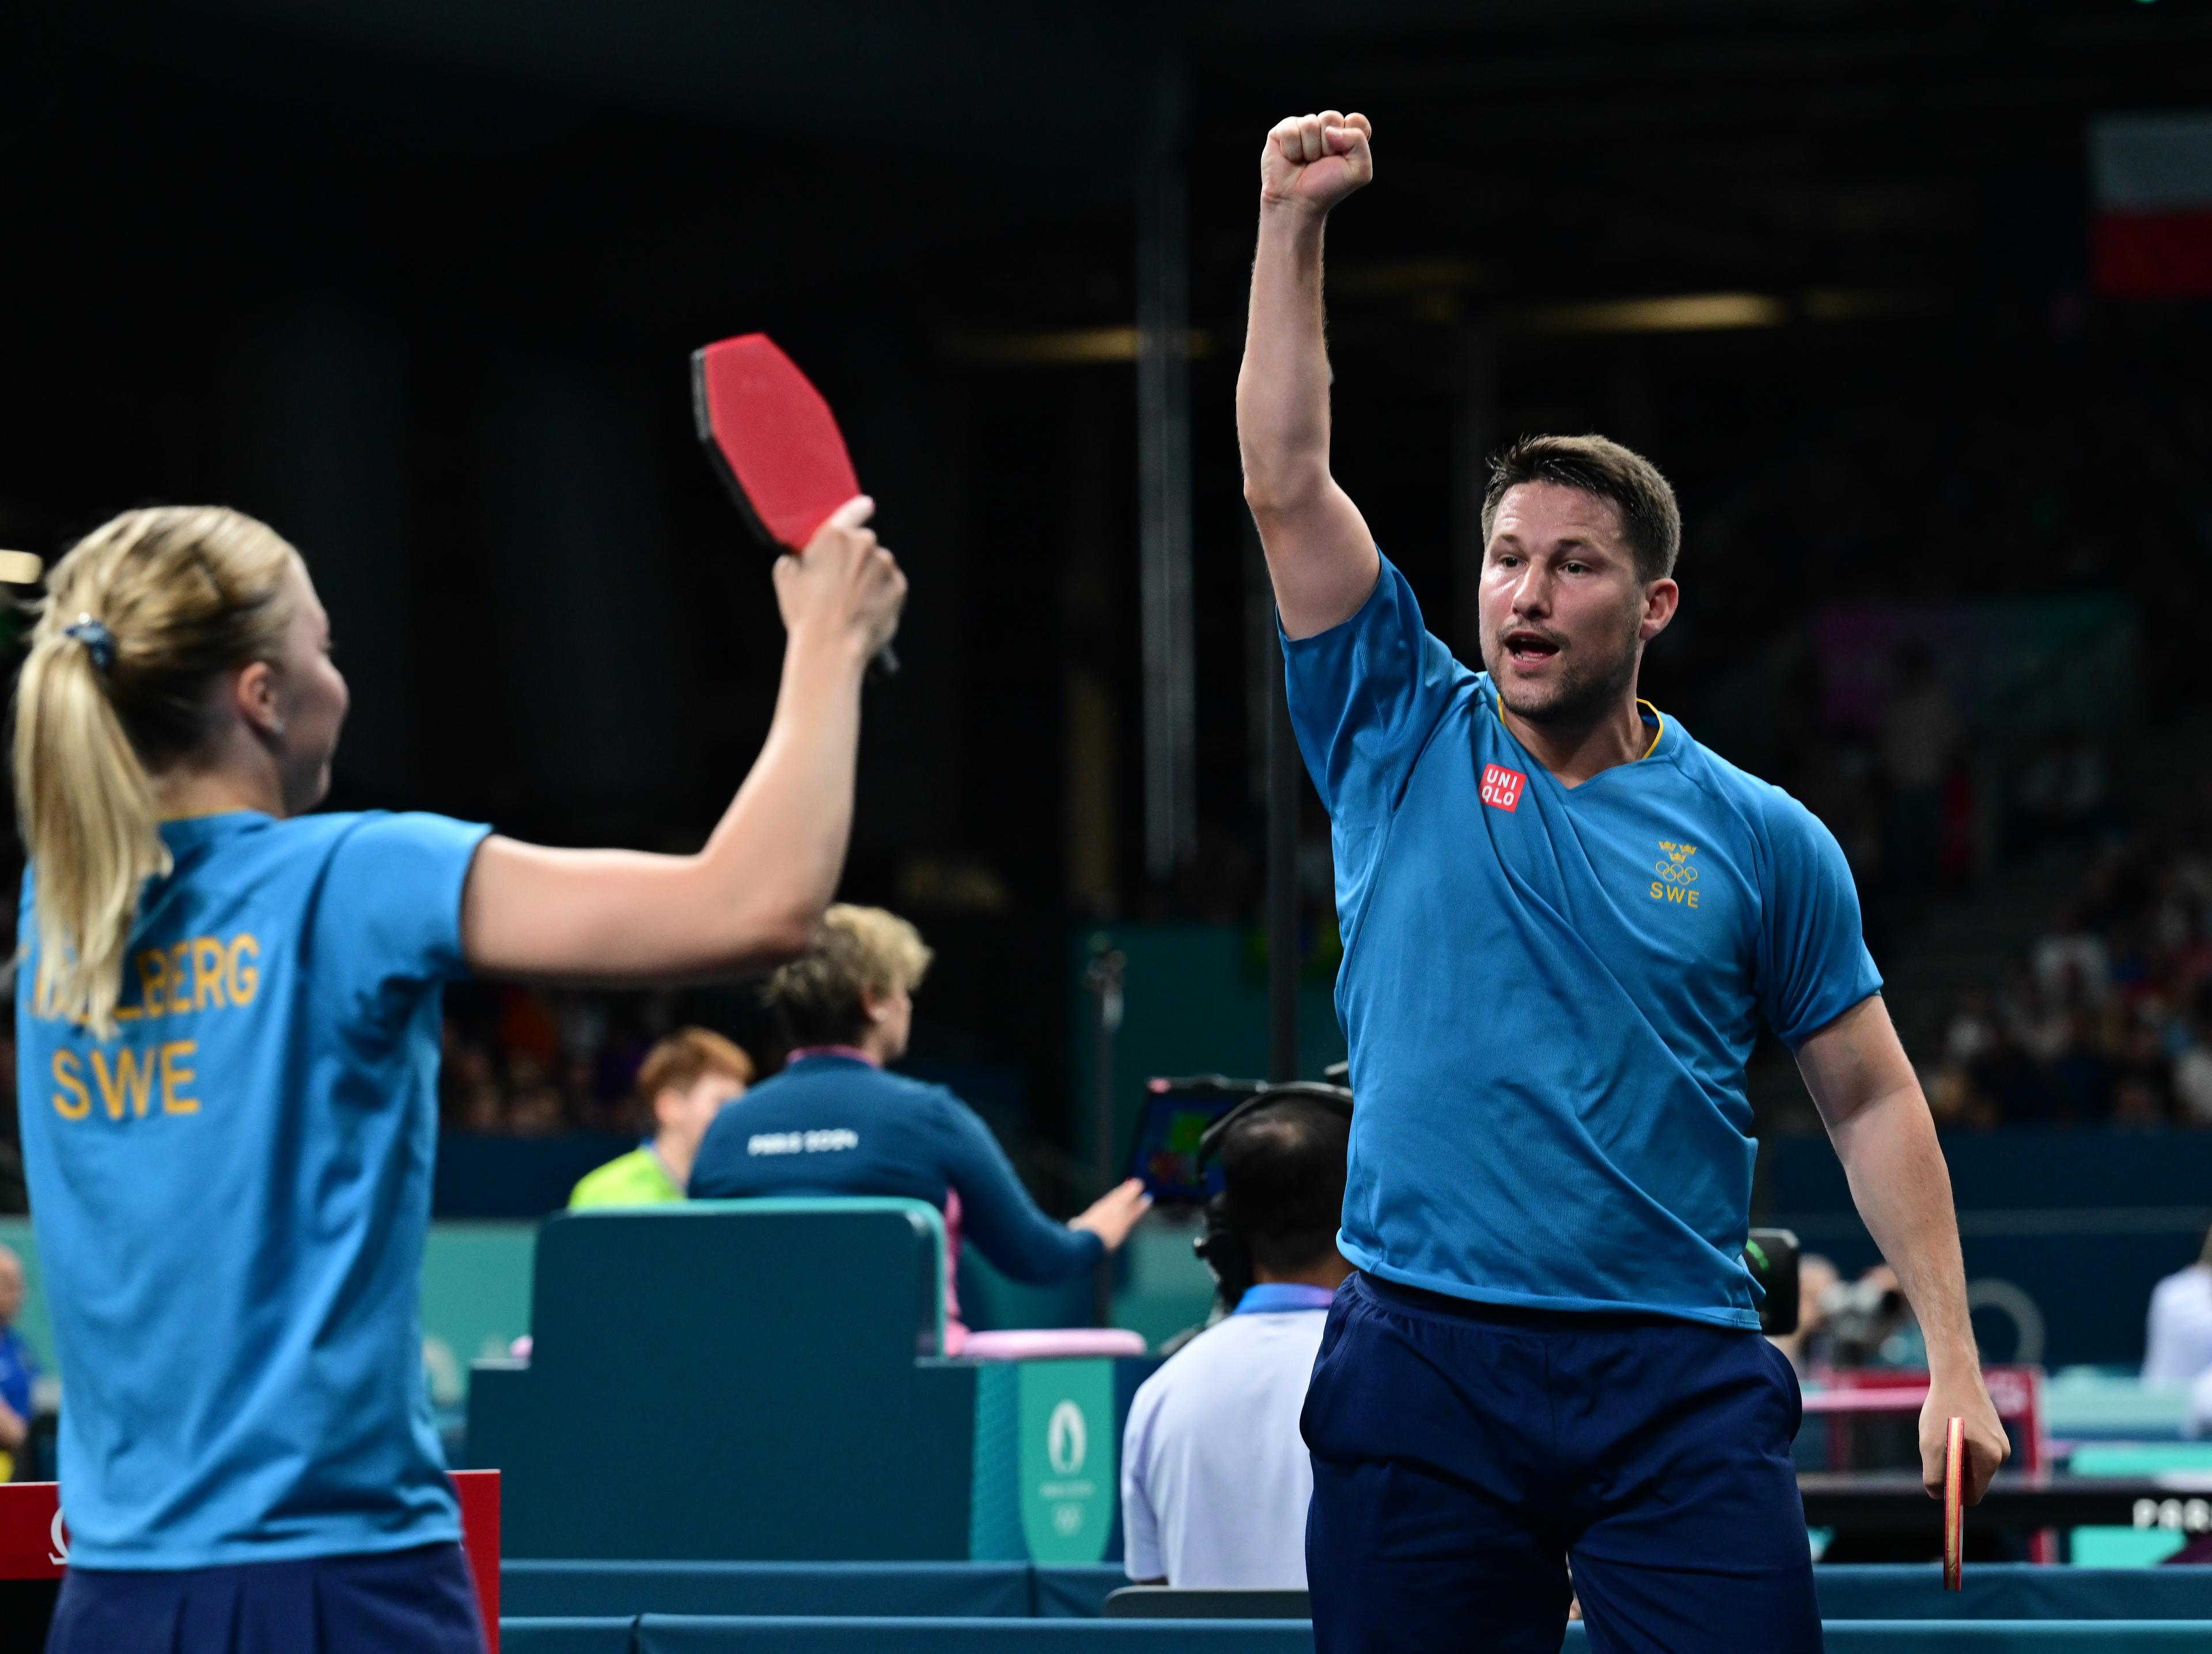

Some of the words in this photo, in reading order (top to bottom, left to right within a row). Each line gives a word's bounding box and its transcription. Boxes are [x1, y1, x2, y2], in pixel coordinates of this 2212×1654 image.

[1487, 768, 1518, 790] UNI
[1482, 785, 1514, 807] QLO
[1650, 881, 1700, 909] SWE
[52, 1039, 201, 1120] SWE
